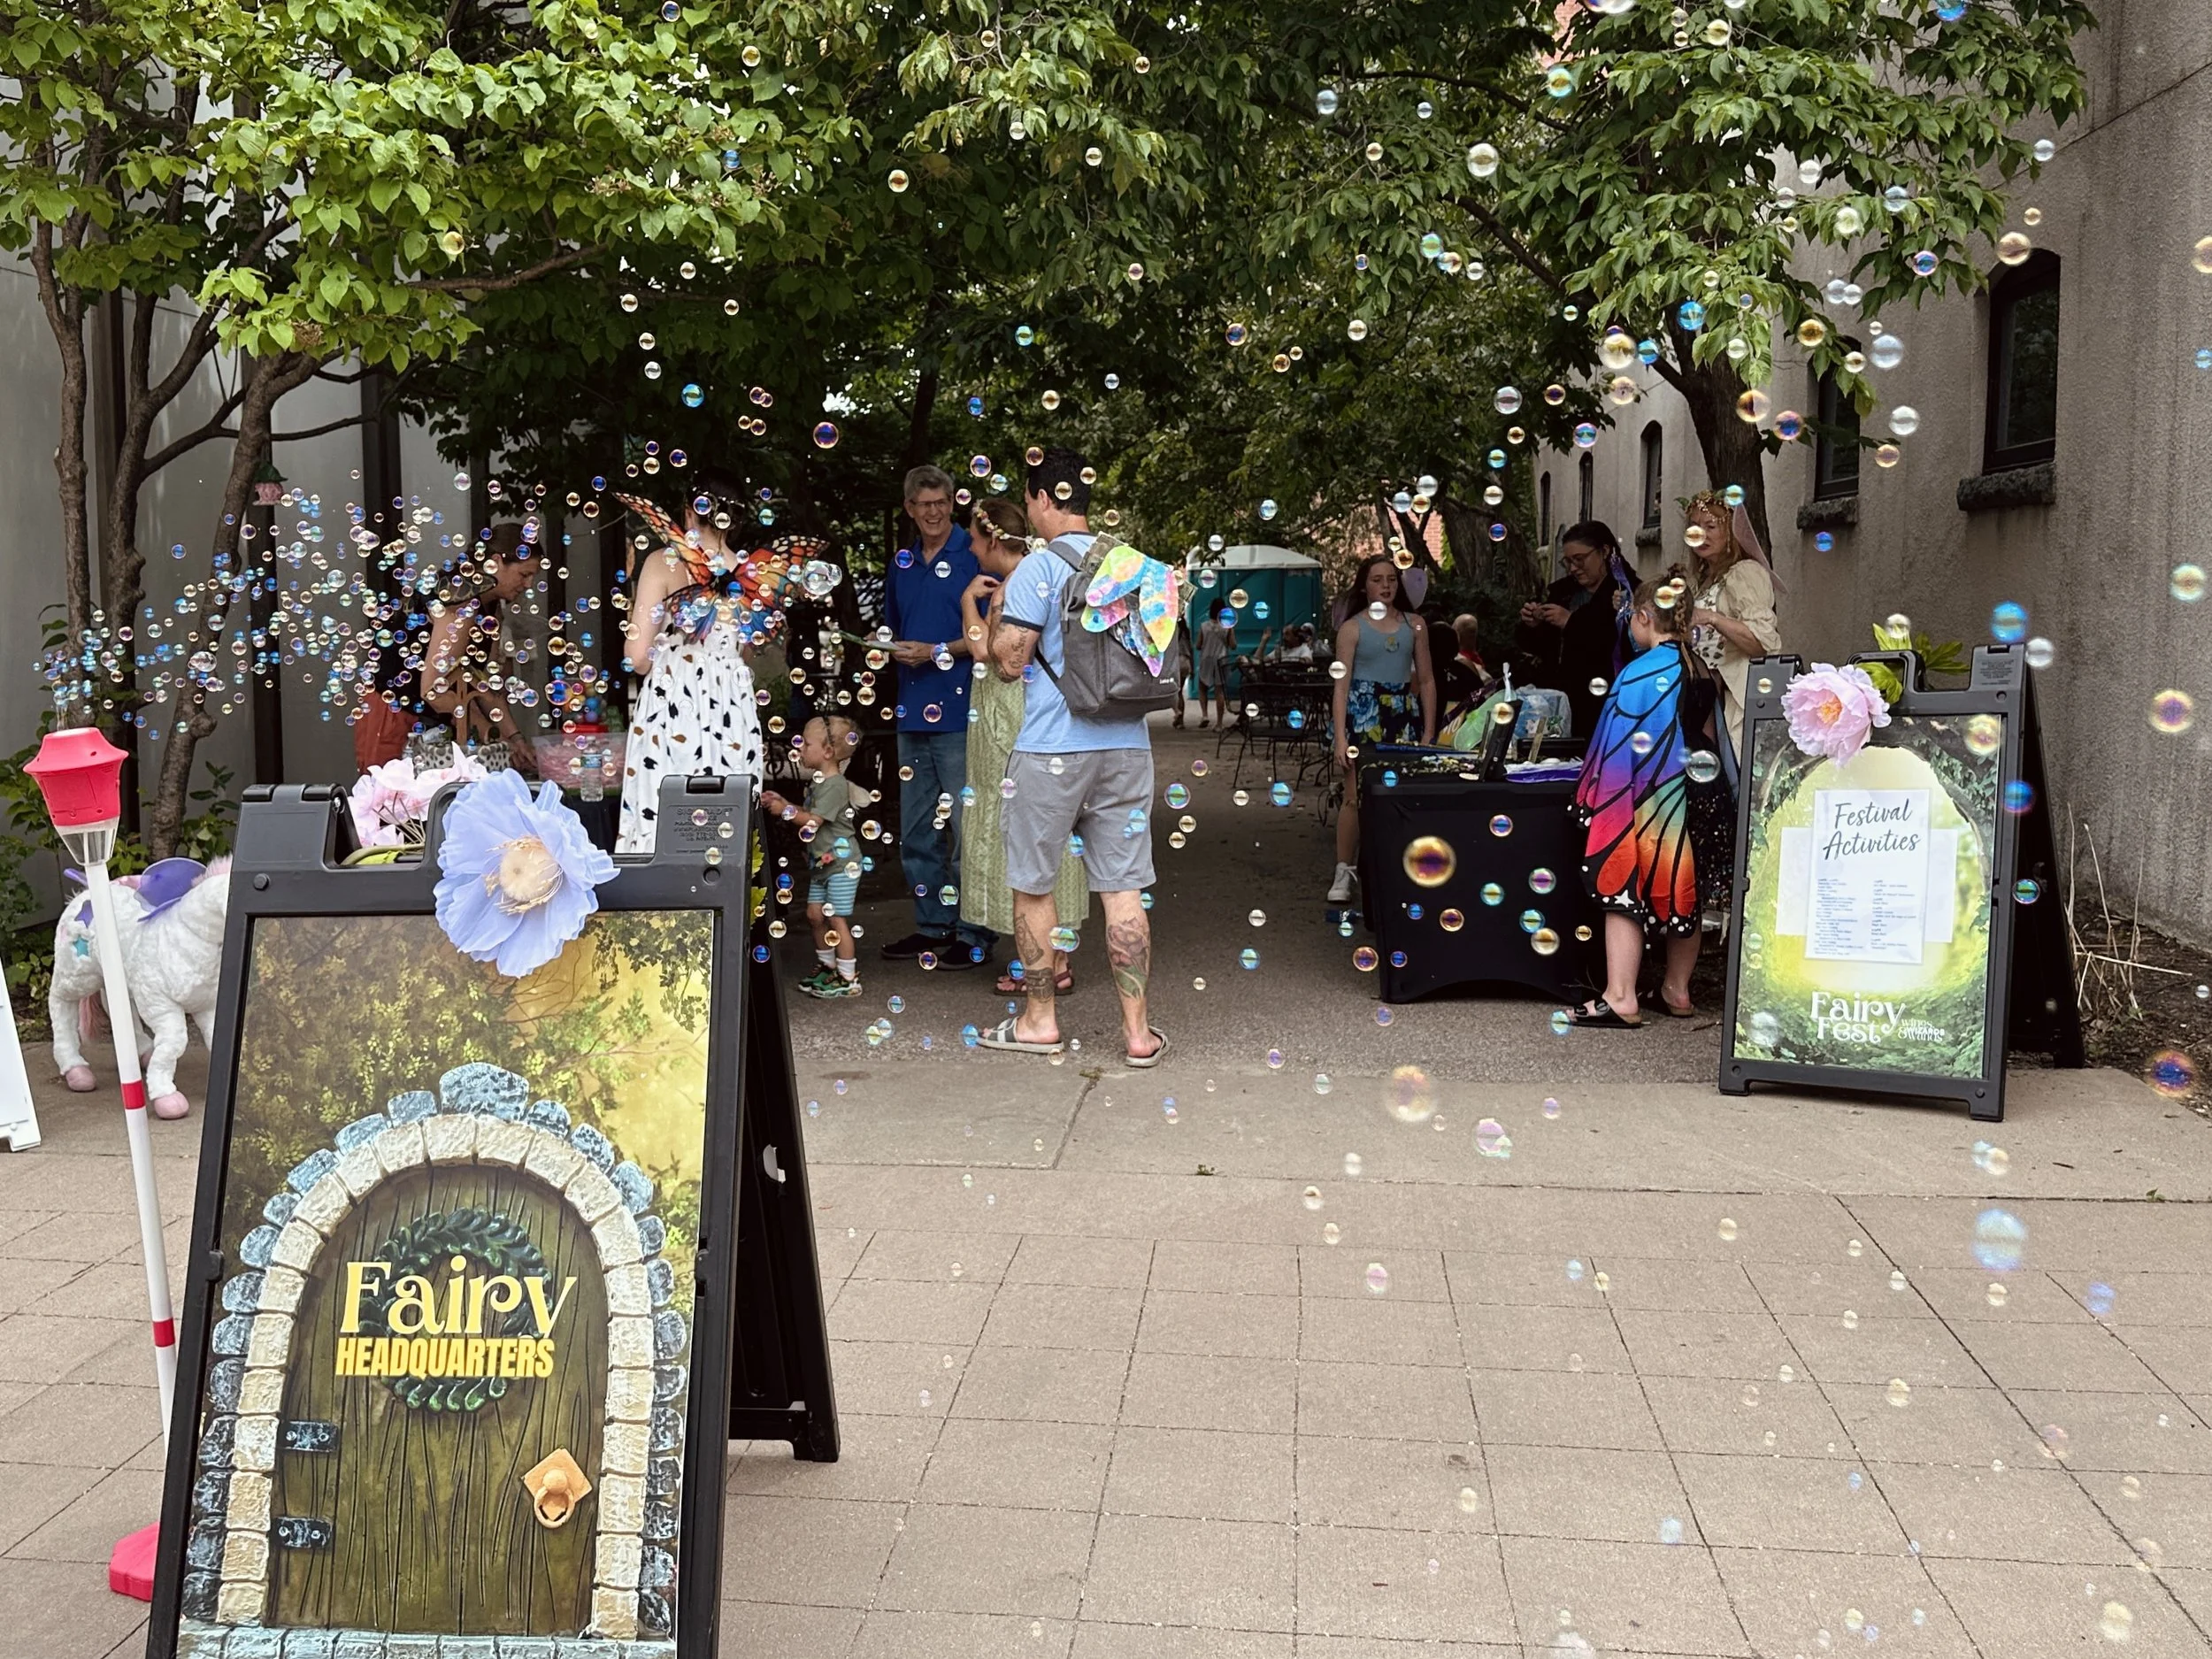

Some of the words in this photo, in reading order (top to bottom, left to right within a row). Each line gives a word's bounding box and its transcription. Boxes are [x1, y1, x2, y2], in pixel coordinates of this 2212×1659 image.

[1834, 798, 1913, 829] Festival
[1823, 829, 1921, 860] Activities
[1810, 991, 1907, 1034] Fairy
[1816, 1016, 1882, 1044] Fest
[340, 1255, 577, 1341] Fairy
[335, 1337, 555, 1380] HEADQUARTERS
